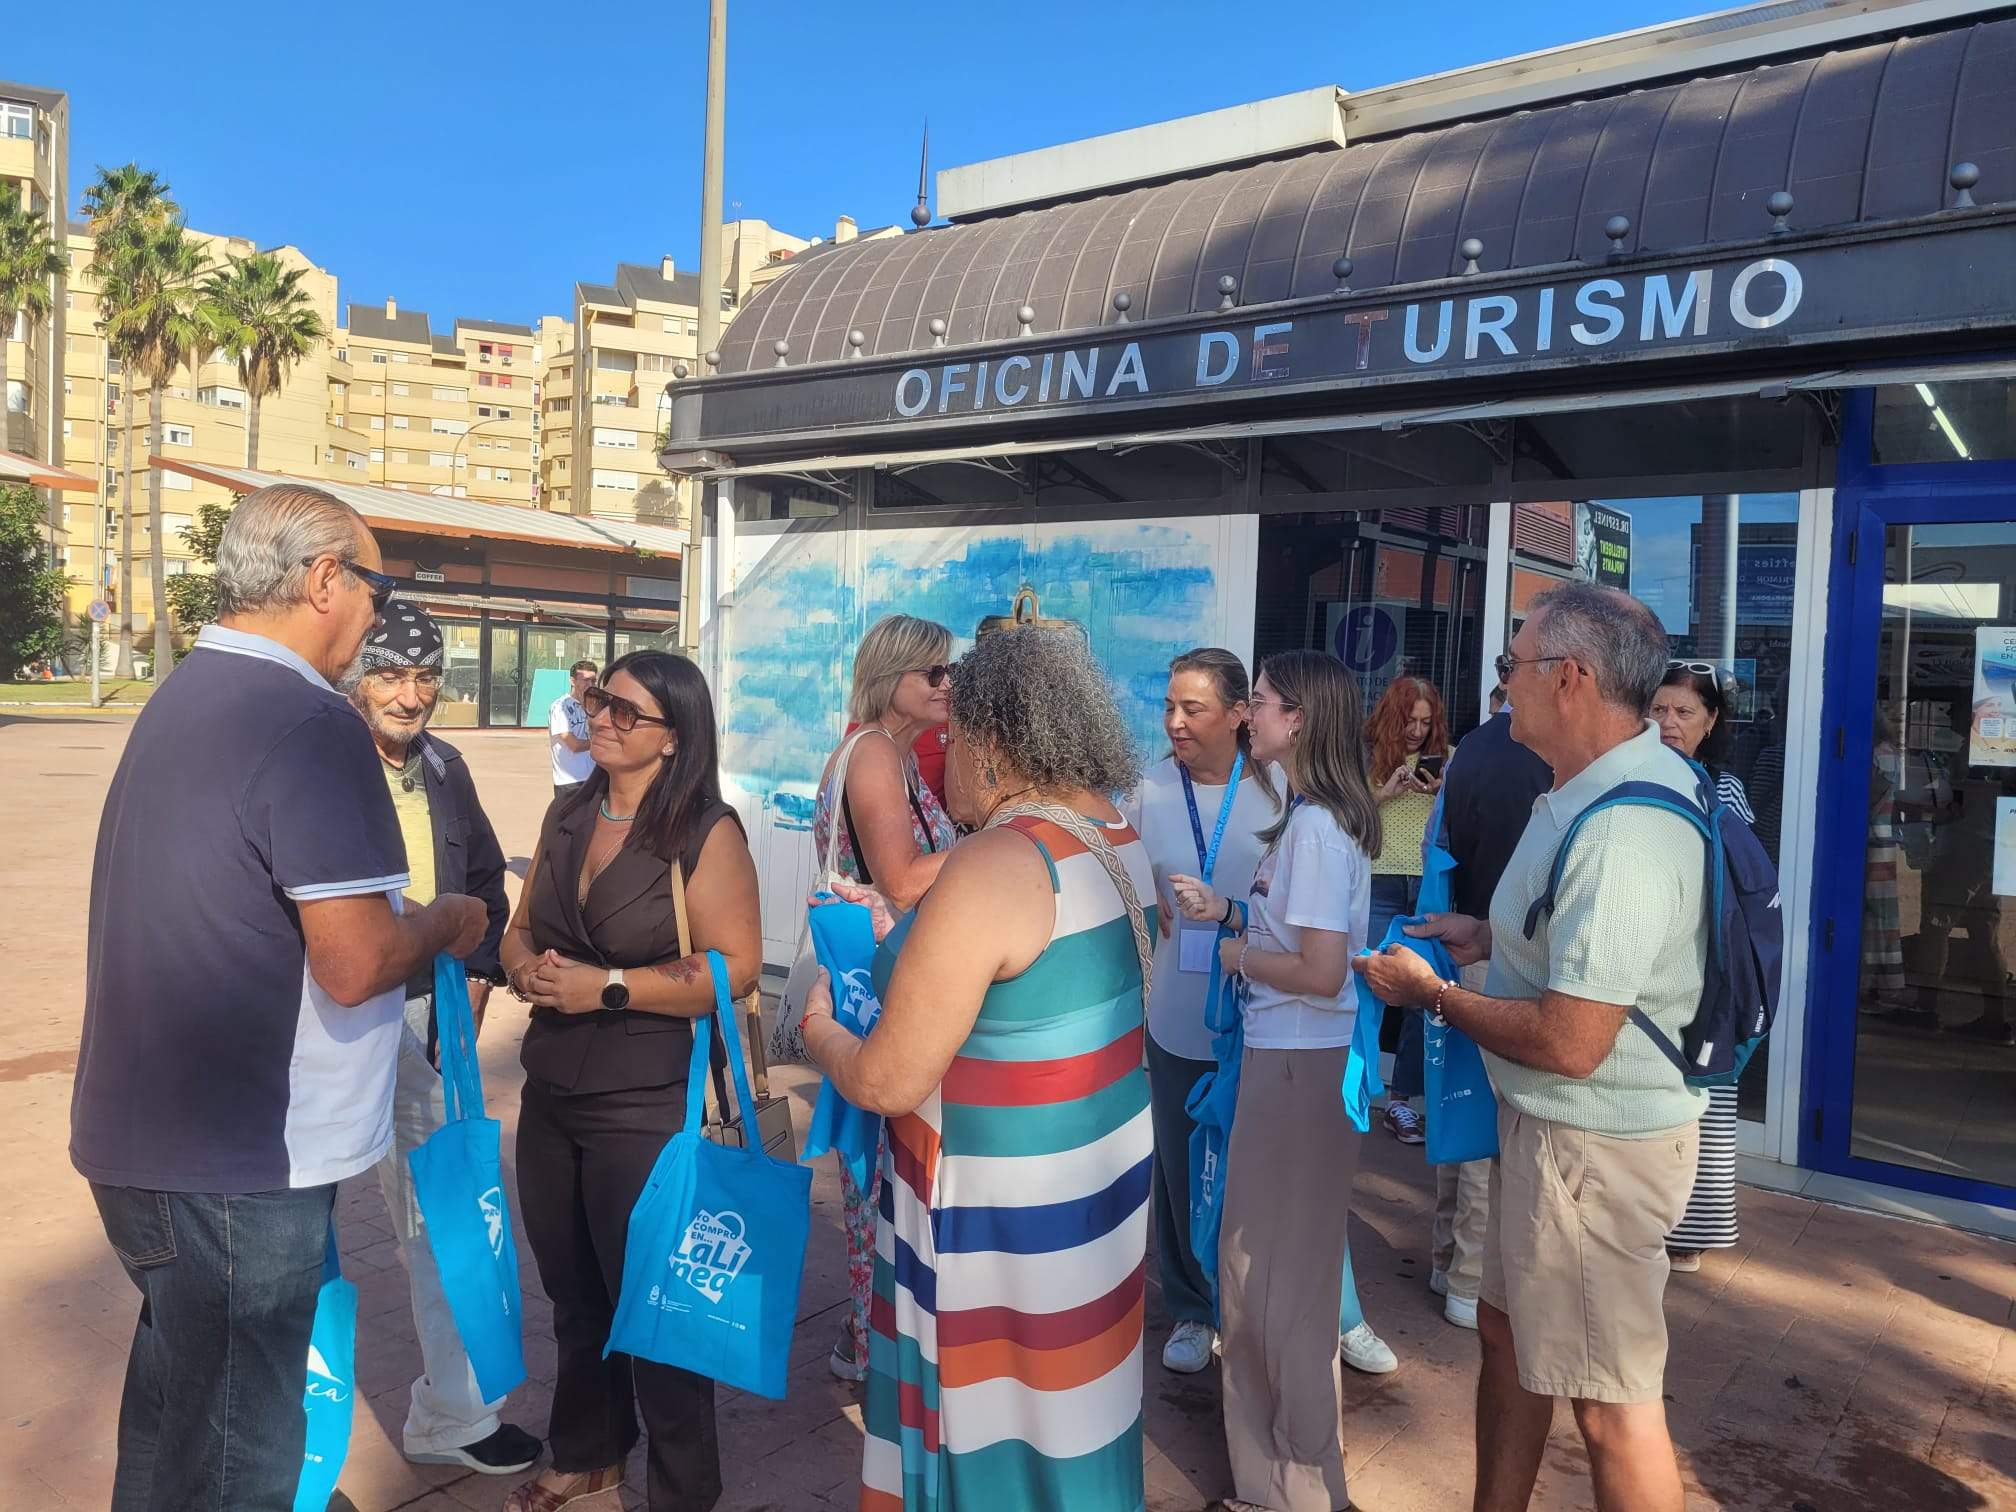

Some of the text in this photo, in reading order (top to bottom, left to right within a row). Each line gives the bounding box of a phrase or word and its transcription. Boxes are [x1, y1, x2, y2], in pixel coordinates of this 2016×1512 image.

[896, 258, 1803, 416] OFICINA DE TURISMO
[693, 1222, 738, 1240] COMPRO
